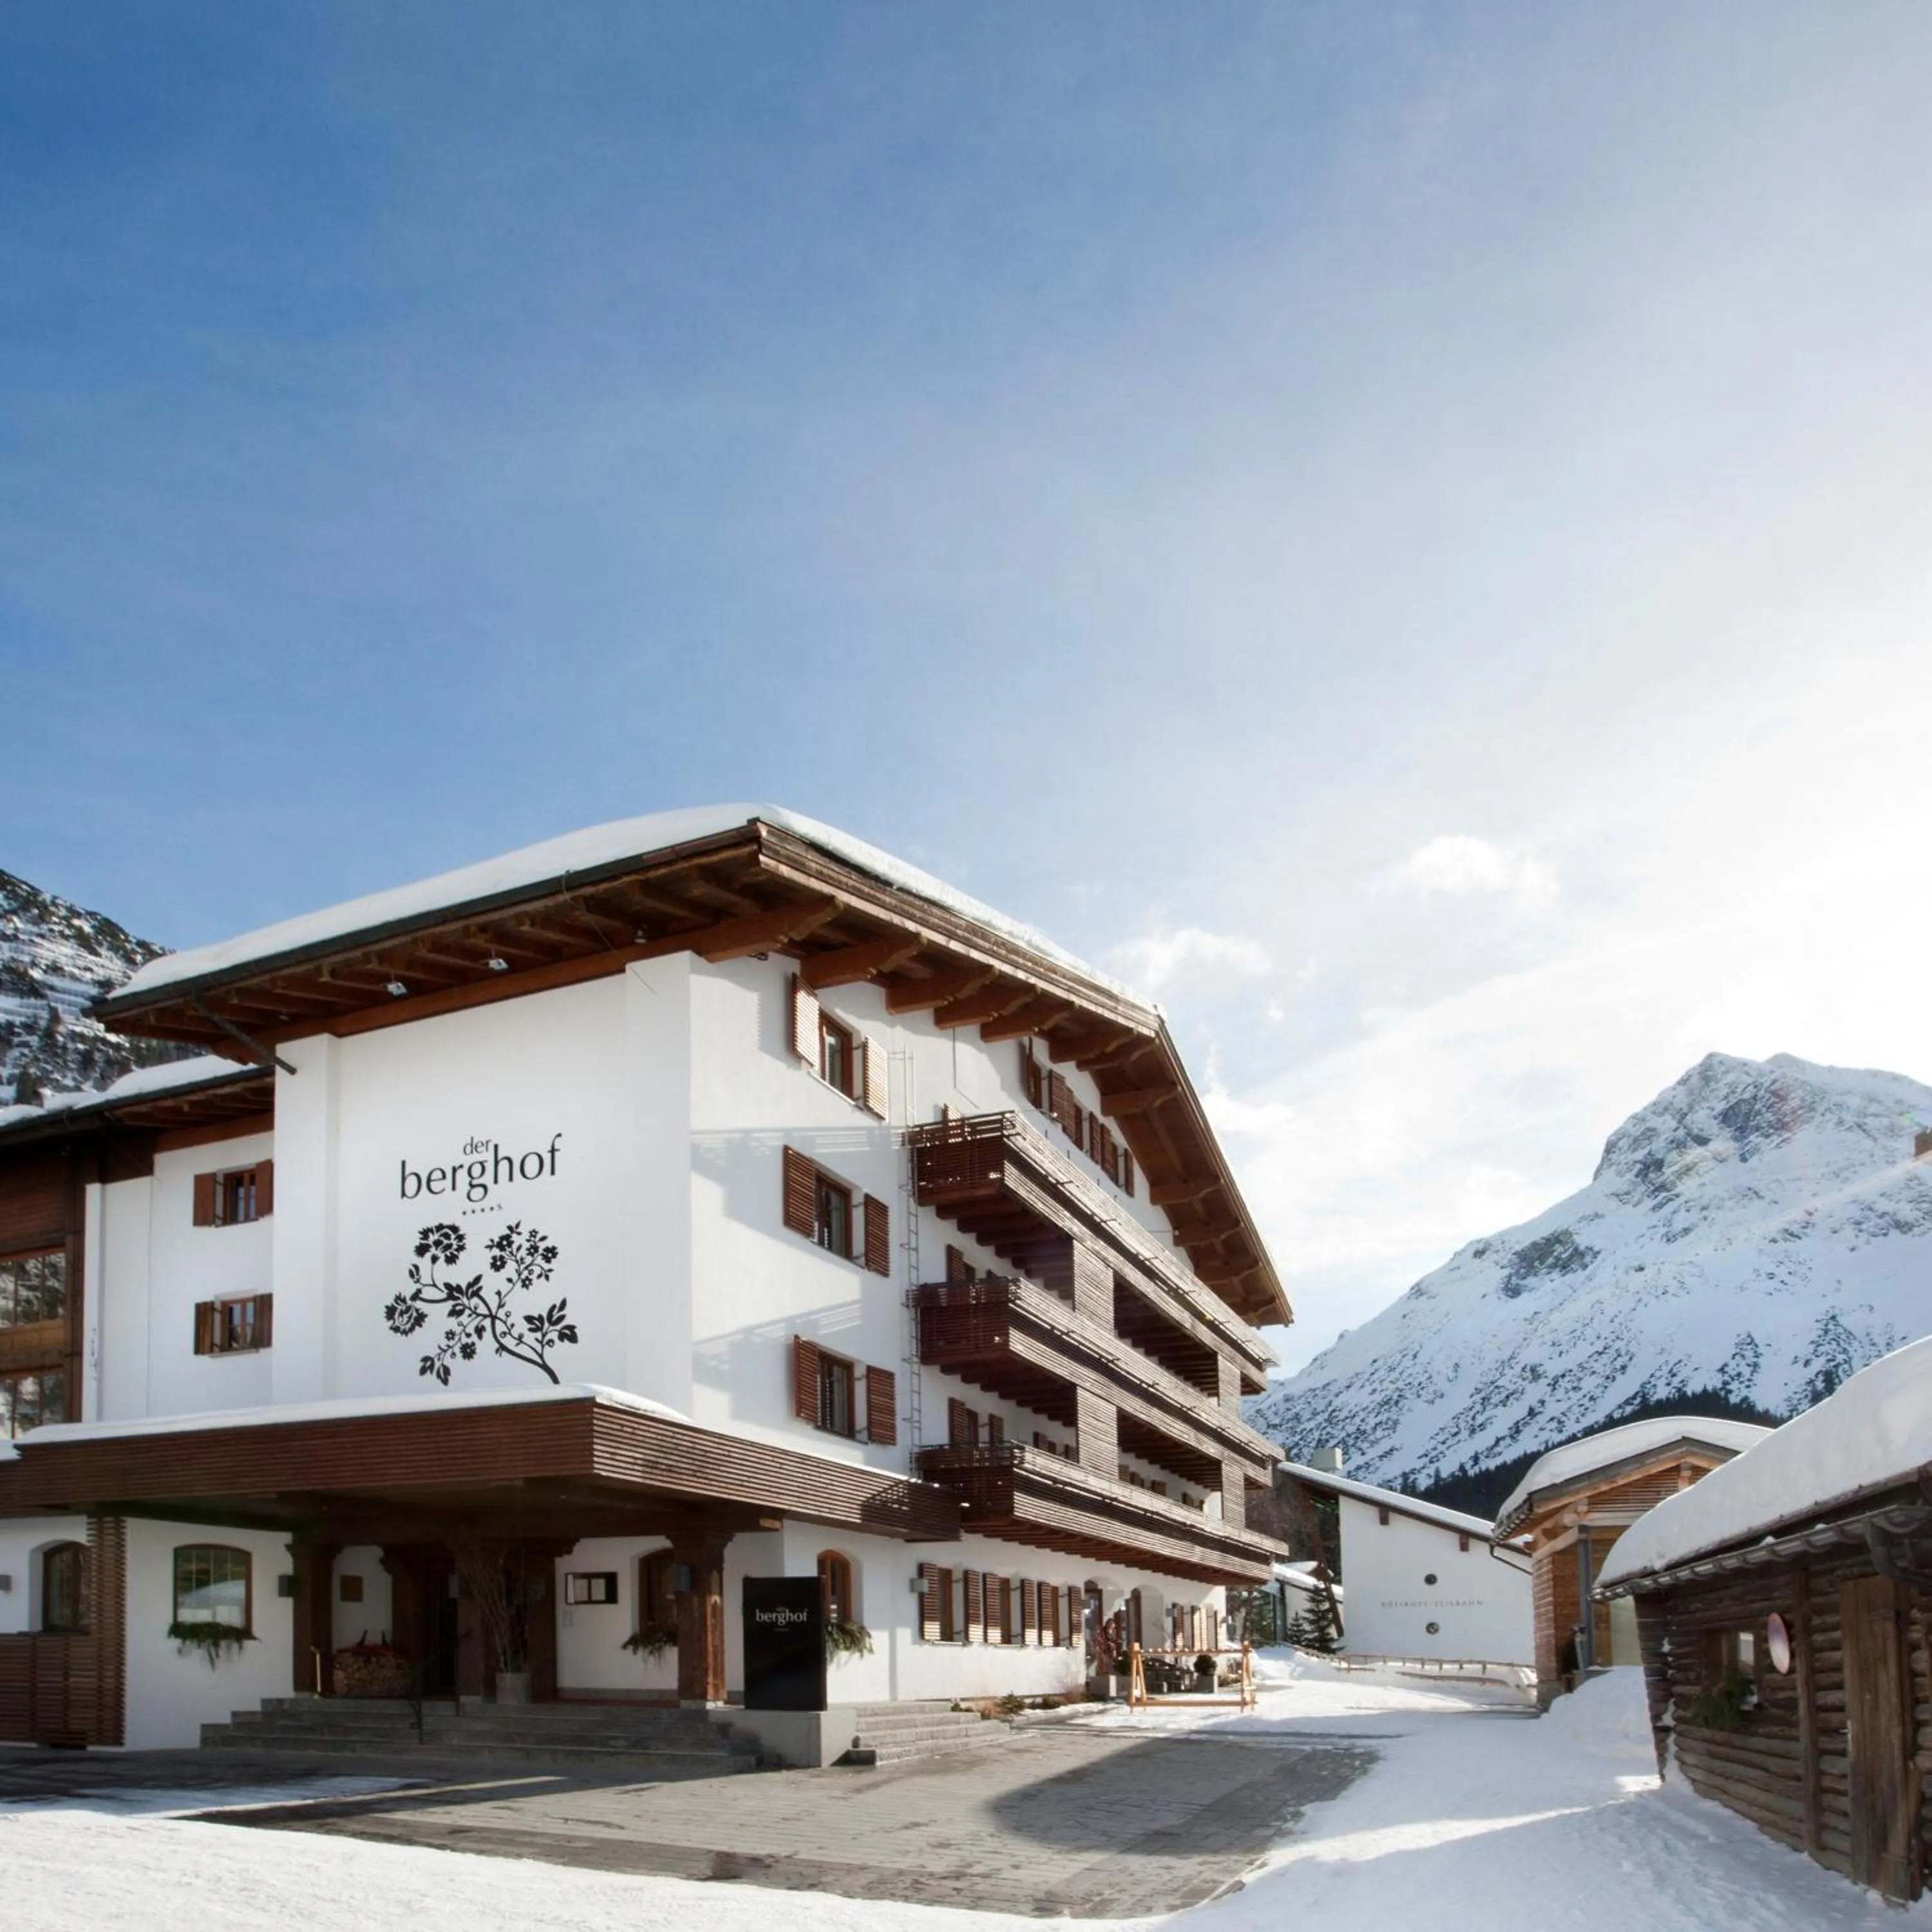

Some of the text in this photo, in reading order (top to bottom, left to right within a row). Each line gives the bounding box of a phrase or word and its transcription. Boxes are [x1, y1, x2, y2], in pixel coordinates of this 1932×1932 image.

[463, 1136, 491, 1156] der
[400, 1133, 562, 1203] berghof
[755, 1608, 809, 1626] berghof
